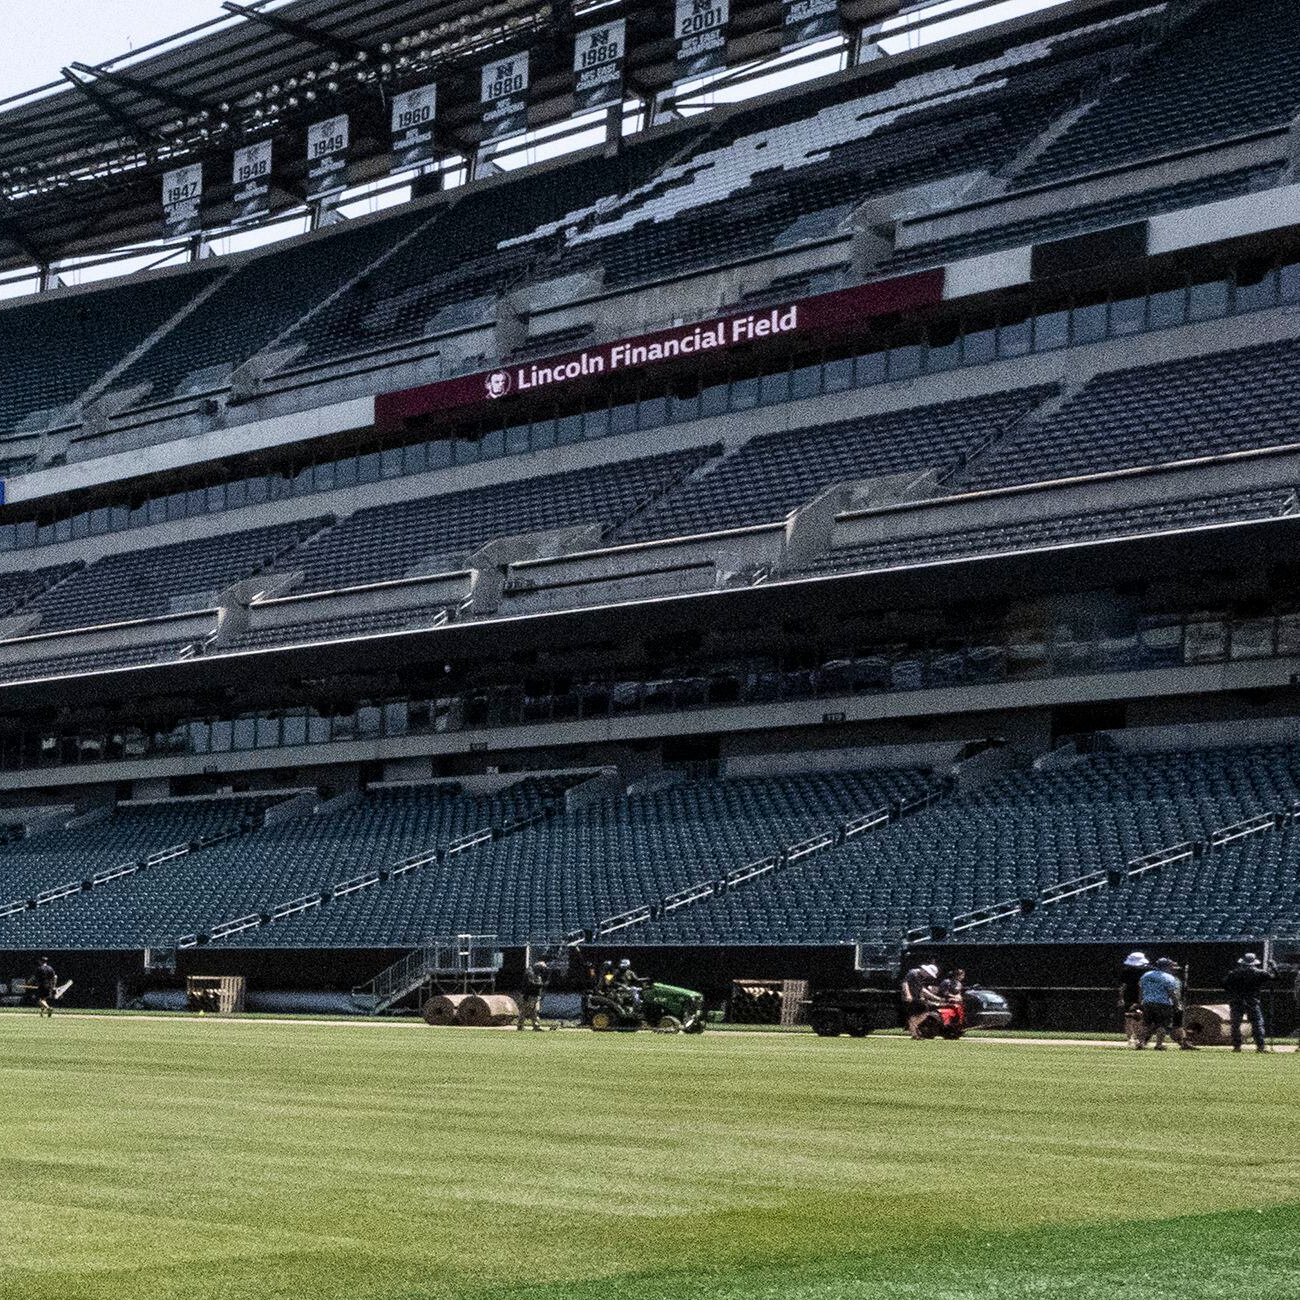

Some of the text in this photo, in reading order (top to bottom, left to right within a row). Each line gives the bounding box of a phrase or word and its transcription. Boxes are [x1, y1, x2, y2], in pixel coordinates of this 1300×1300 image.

[681, 8, 721, 35] 2001
[581, 42, 618, 67] 1988
[487, 74, 523, 98] 1980
[399, 106, 430, 127] 1960
[313, 135, 343, 157] 1949
[239, 161, 267, 181] 1948
[168, 182, 198, 201] 1947
[518, 305, 798, 390] Lincoln Financial Field
